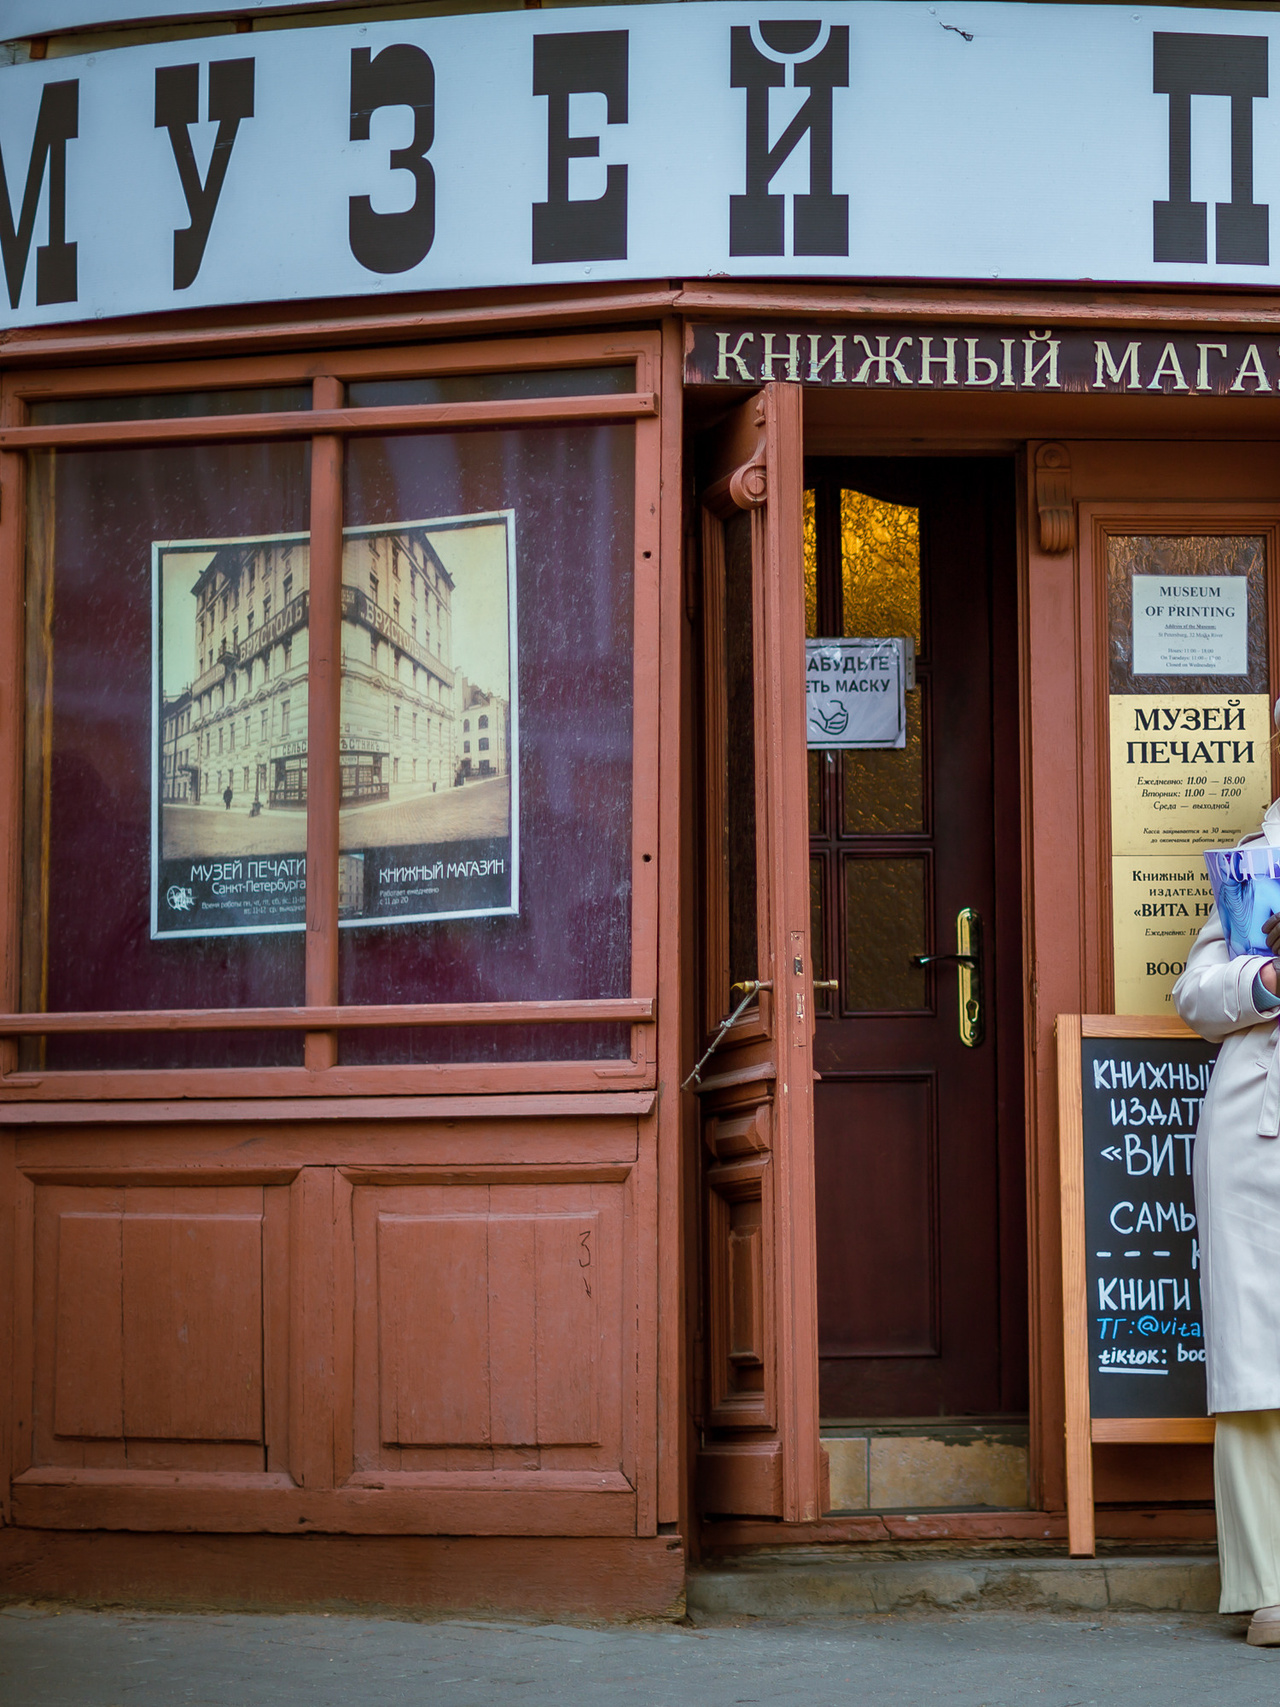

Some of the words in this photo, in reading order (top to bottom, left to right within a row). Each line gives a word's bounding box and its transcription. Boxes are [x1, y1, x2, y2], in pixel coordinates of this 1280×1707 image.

[0, 19, 850, 310] МУЗЕЙ
[714, 330, 1061, 387] КНИЖНЫЙ
[1159, 586, 1221, 597] MUSEUM
[1145, 606, 1164, 617] OF
[1168, 606, 1235, 618] PRINTING
[805, 656, 889, 674] АБУДЬТЕ
[836, 679, 890, 693] МАСКУ
[1134, 699, 1245, 731] МУЗЕЙ
[1126, 741, 1255, 764] ПЕЧАТИ
[1137, 776, 1183, 786] Ежедневно:
[1187, 776, 1207, 785] 11.00
[1223, 776, 1245, 785] 18.00
[1141, 788, 1181, 799] Вторник:
[1184, 788, 1205, 797] 11.00
[1220, 788, 1242, 797] 17.00
[1153, 800, 1177, 811] Среда
[1192, 801, 1230, 810] выходной
[190, 859, 242, 881] МУЗЕЙ
[248, 858, 306, 879] ПЕЧАТИ
[379, 861, 443, 884] КНИЖНЫЙ
[447, 858, 504, 879] МАГАЗИН
[1132, 870, 1194, 882] Книжный
[212, 878, 306, 895] Санкт-Петербурга
[1134, 903, 1189, 917] «ВИТА
[1145, 928, 1186, 937] Ежедневно:
[1146, 962, 1186, 976] BOO
[1098, 1277, 1191, 1311] КНИГИ
[1098, 1346, 1167, 1364] tiktok:
